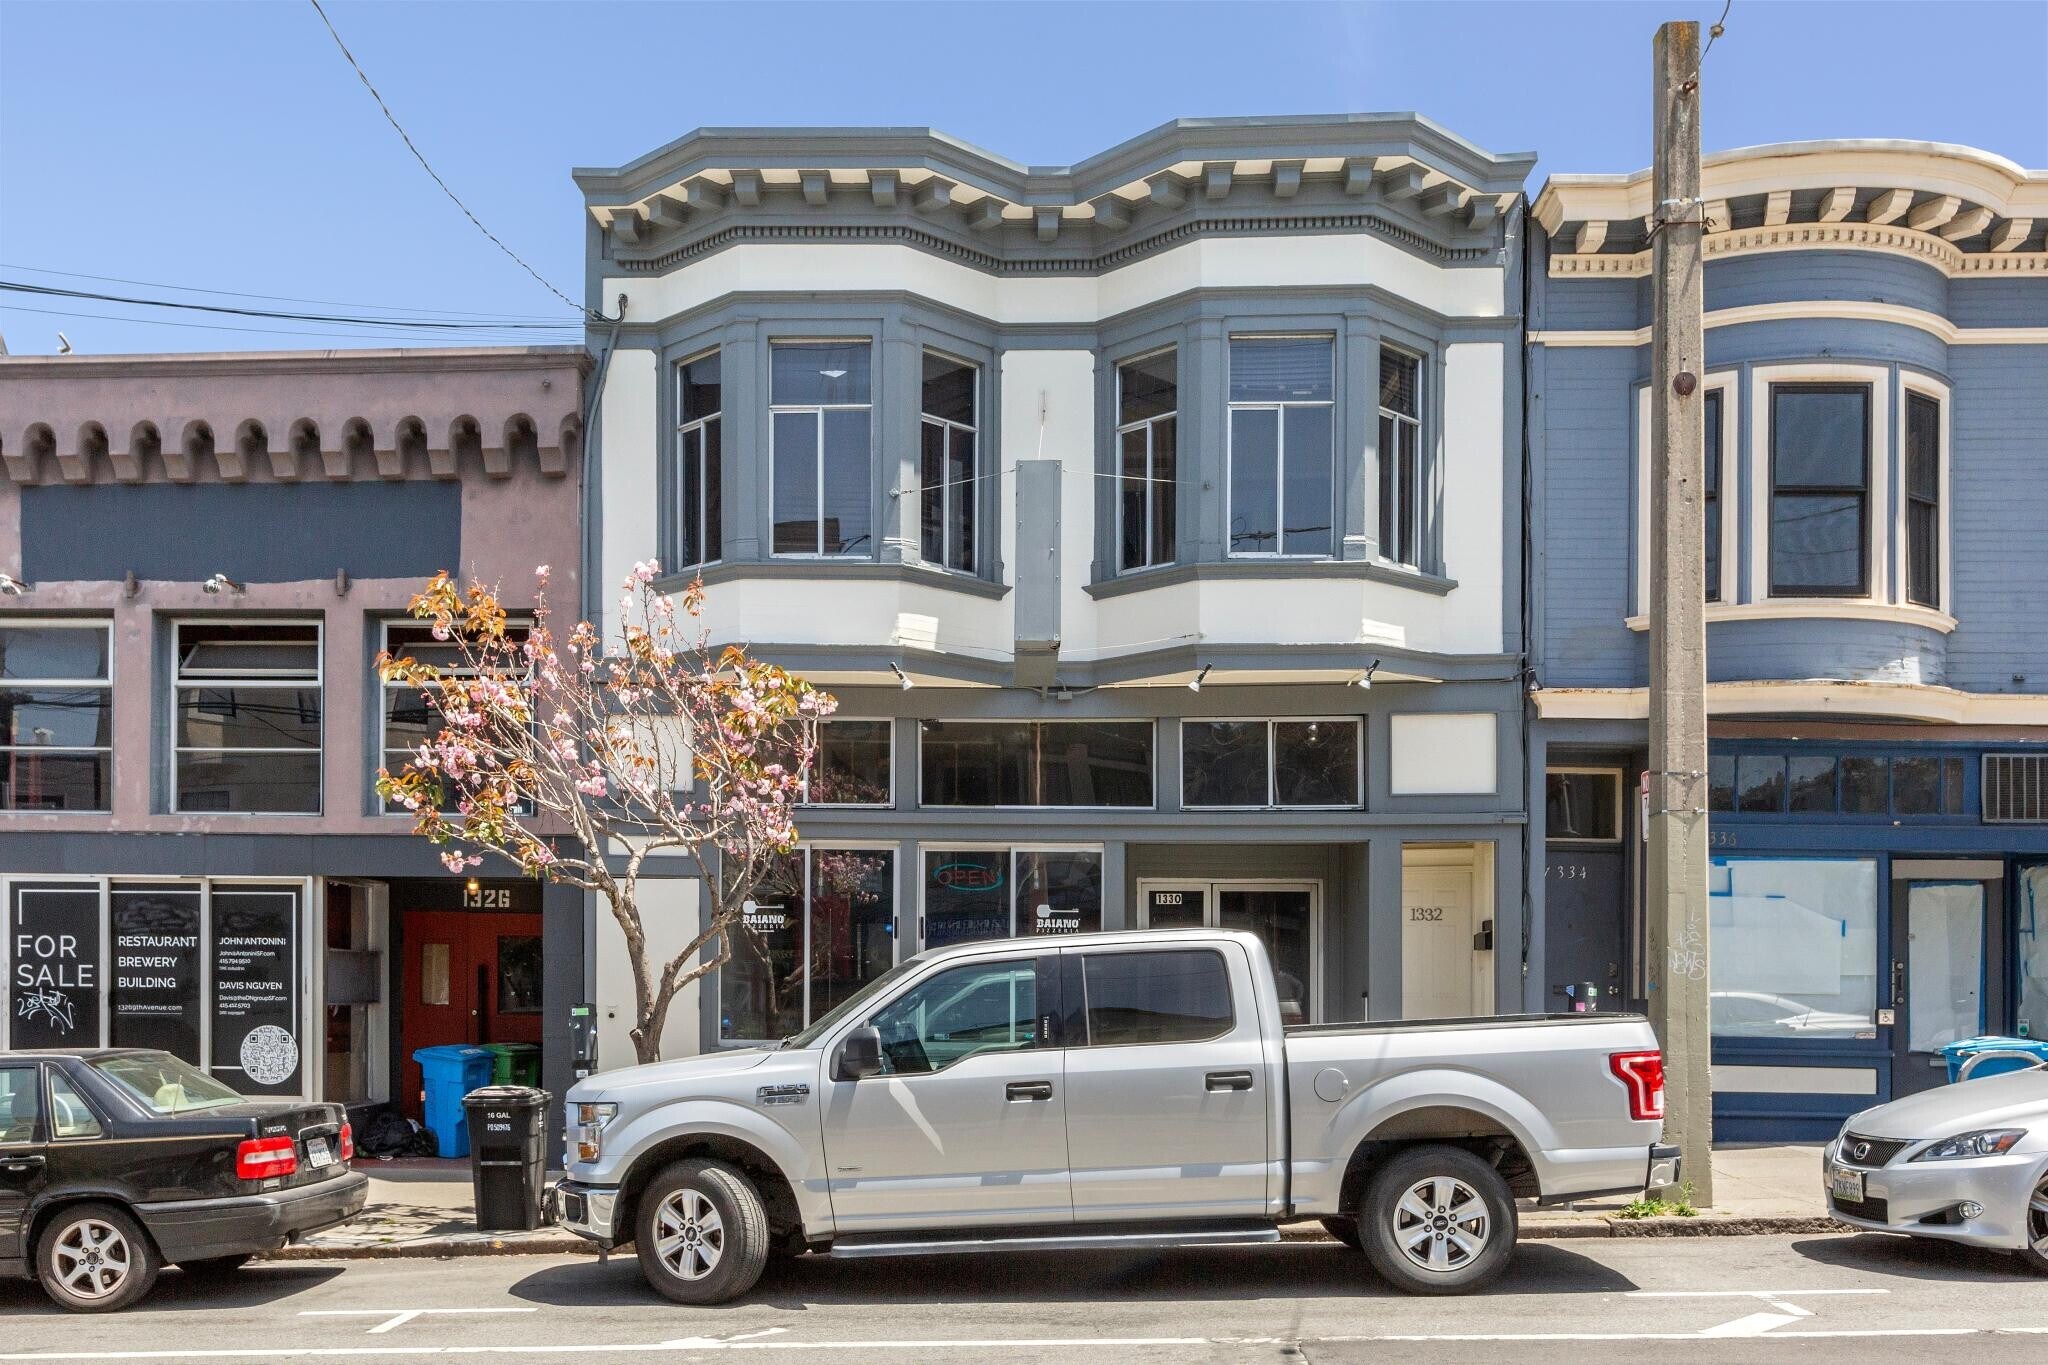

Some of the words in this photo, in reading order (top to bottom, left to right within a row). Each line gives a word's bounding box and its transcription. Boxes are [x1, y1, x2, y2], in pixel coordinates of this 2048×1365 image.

[1710, 831, 1737, 847] 336
[938, 870, 996, 885] OPEN
[1158, 894, 1181, 904] 1330
[742, 914, 785, 924] BAIANO
[1409, 907, 1443, 922] 1332
[1036, 918, 1079, 928] BAIANO
[17, 934, 77, 958] FOR
[118, 936, 198, 947] RESTAURANT
[219, 937, 243, 945] JOHN
[244, 937, 286, 945] ANTONINI
[118, 956, 178, 967] BREWERY
[17, 963, 94, 987] SALE
[118, 977, 177, 988] BUILDING
[219, 981, 244, 990] DAVIS
[245, 981, 283, 990] NGUYEN
